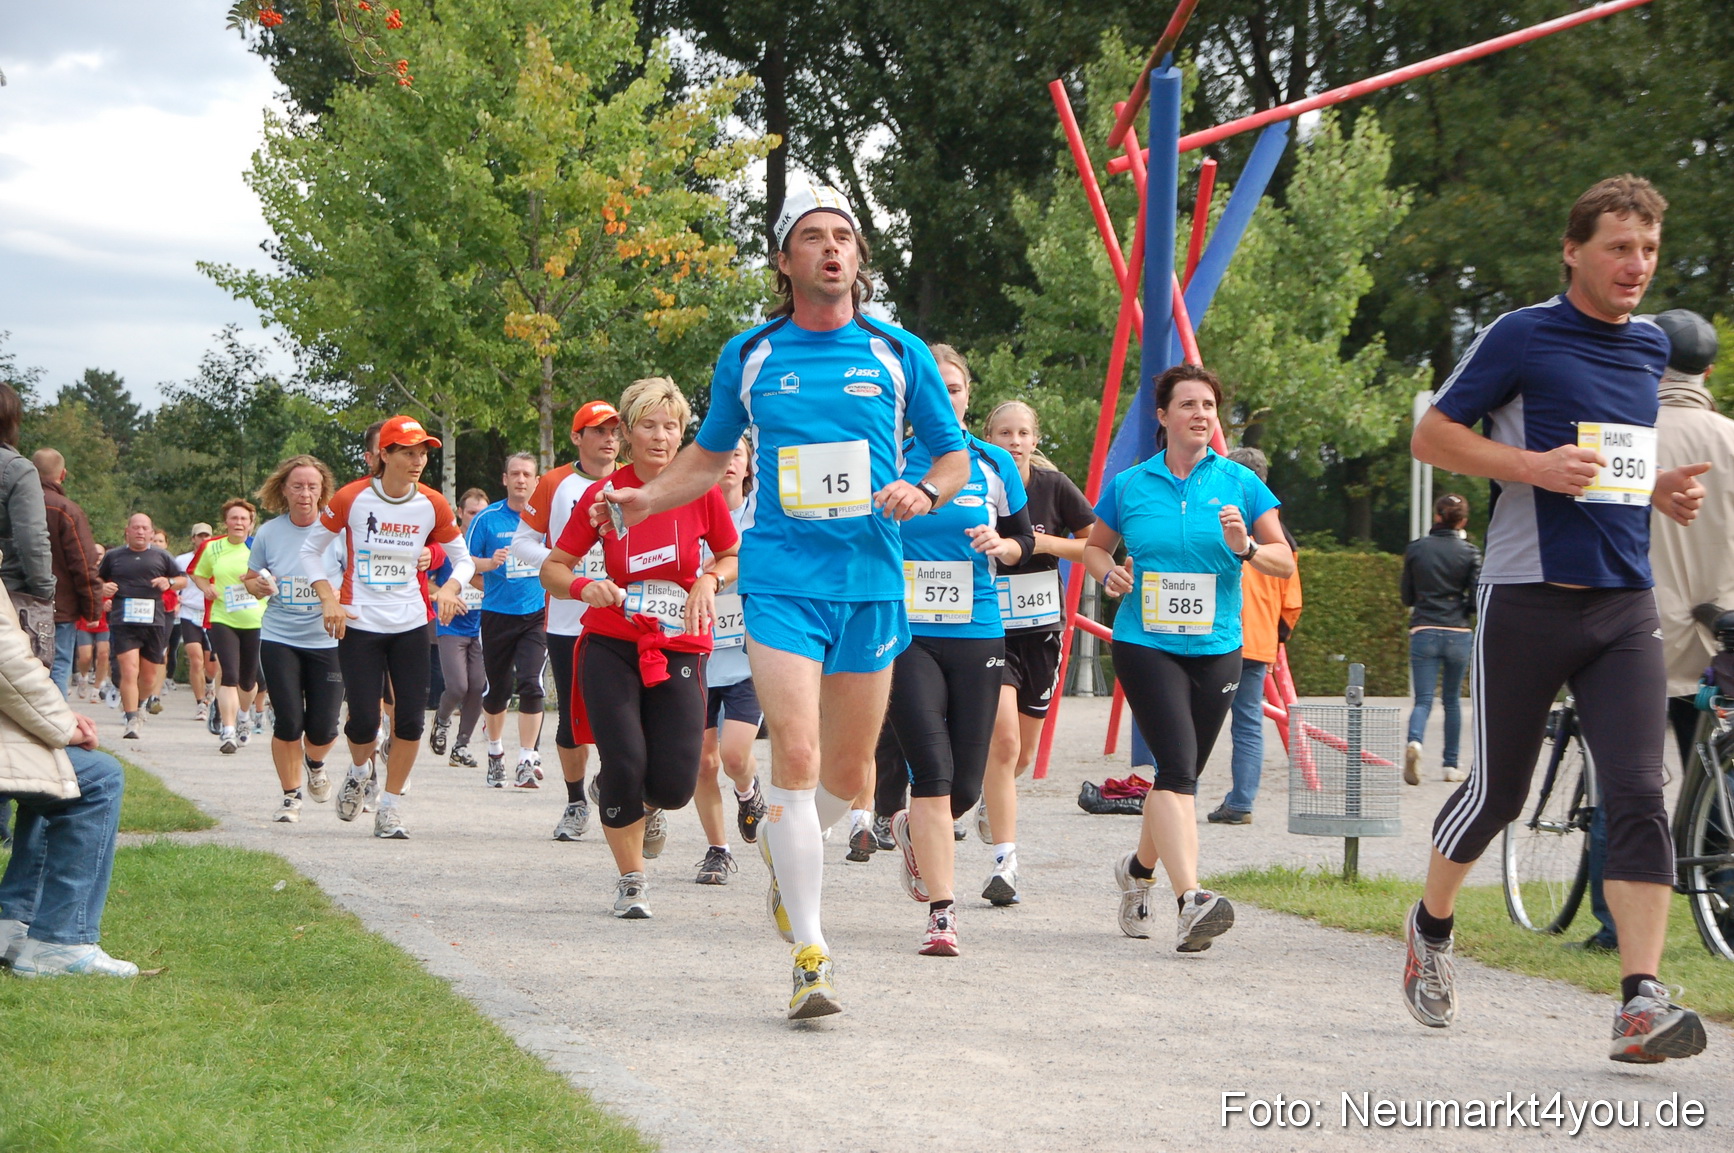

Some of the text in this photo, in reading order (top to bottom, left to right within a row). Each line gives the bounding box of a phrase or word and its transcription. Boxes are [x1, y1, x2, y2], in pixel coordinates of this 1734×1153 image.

[1604, 431, 1632, 447] HANS
[1612, 457, 1646, 479] 950
[822, 473, 850, 494] 15
[381, 522, 420, 534] MERZ
[590, 561, 604, 572] 27
[642, 553, 663, 565] DEHN
[374, 565, 406, 576] 2794
[917, 567, 952, 579] Andrea
[295, 587, 318, 598] 206
[647, 584, 686, 599] Elisabeth
[1162, 579, 1196, 591] Sandra
[924, 586, 959, 603] 573
[1017, 591, 1052, 608] 3481
[646, 600, 685, 619] 2385
[1168, 598, 1203, 614] 585
[718, 612, 744, 629] 372
